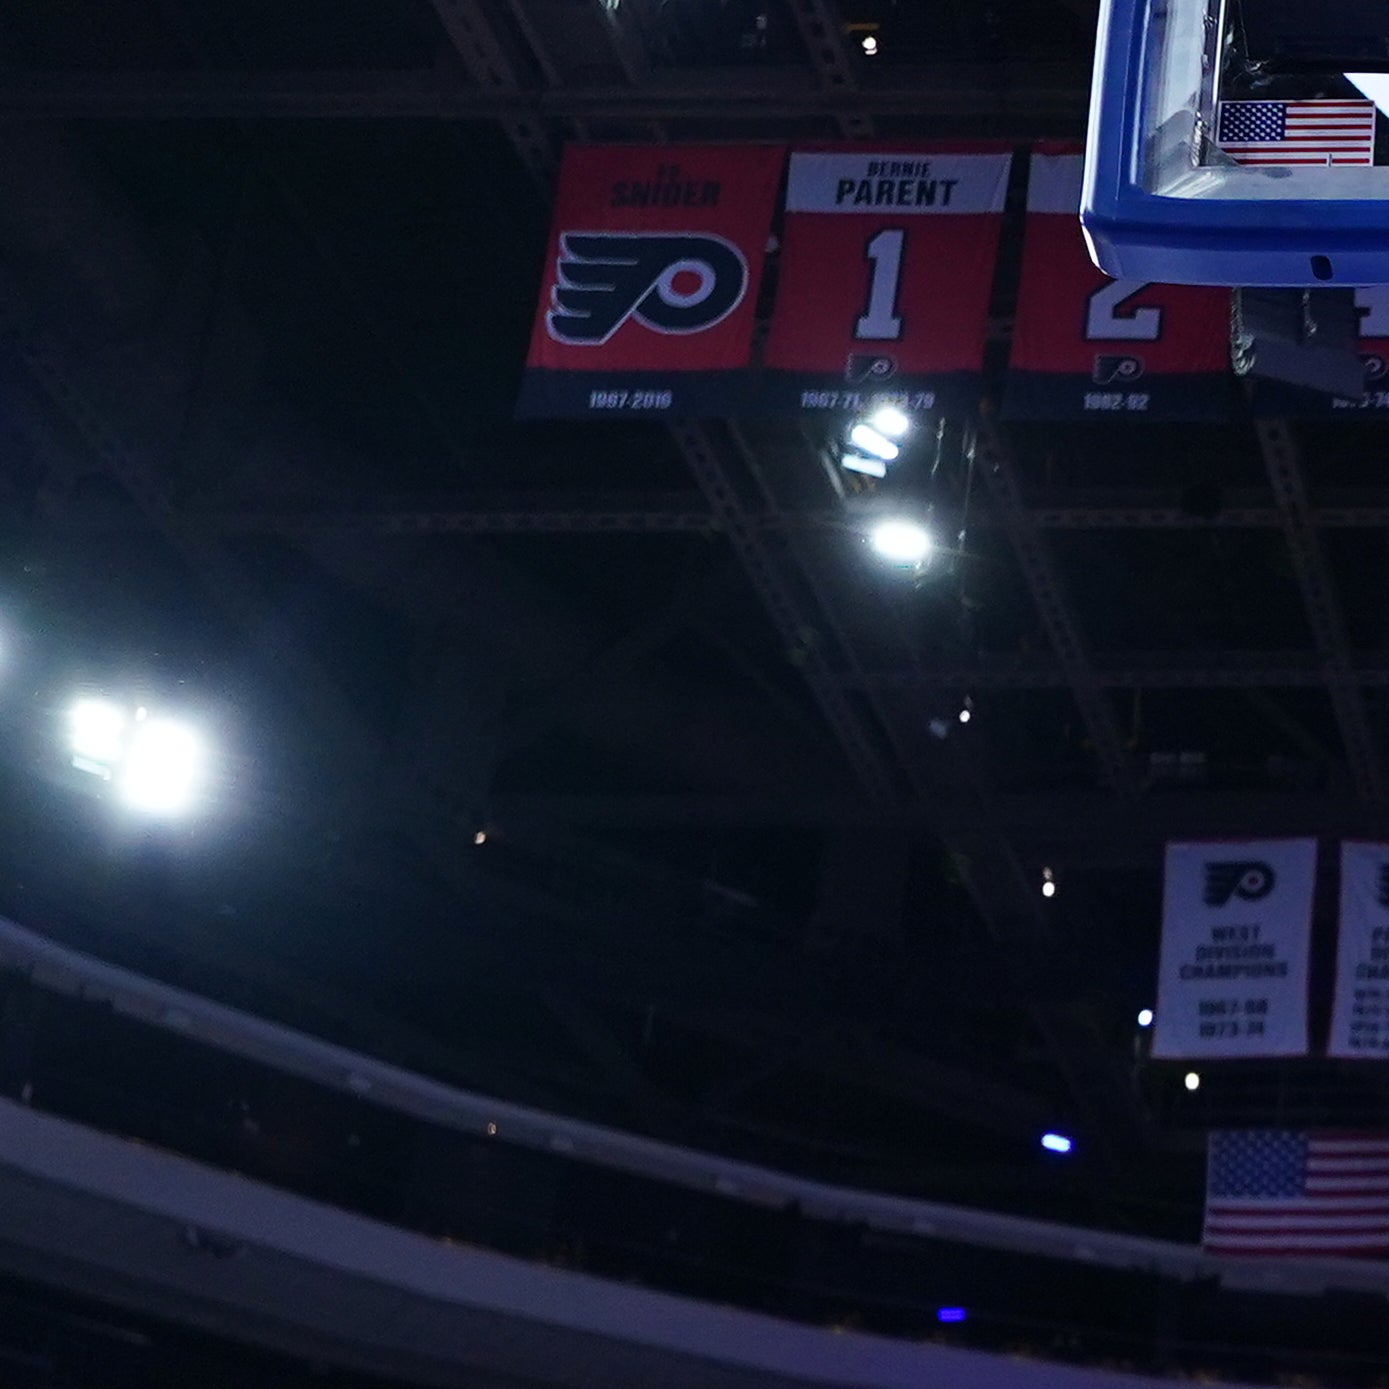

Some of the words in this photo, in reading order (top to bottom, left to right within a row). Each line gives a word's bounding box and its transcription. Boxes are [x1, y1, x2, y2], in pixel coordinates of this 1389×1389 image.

[868, 162, 931, 177] BERNIE
[611, 183, 720, 207] SNIDER
[836, 181, 958, 206] PARENT
[853, 228, 904, 340] 1
